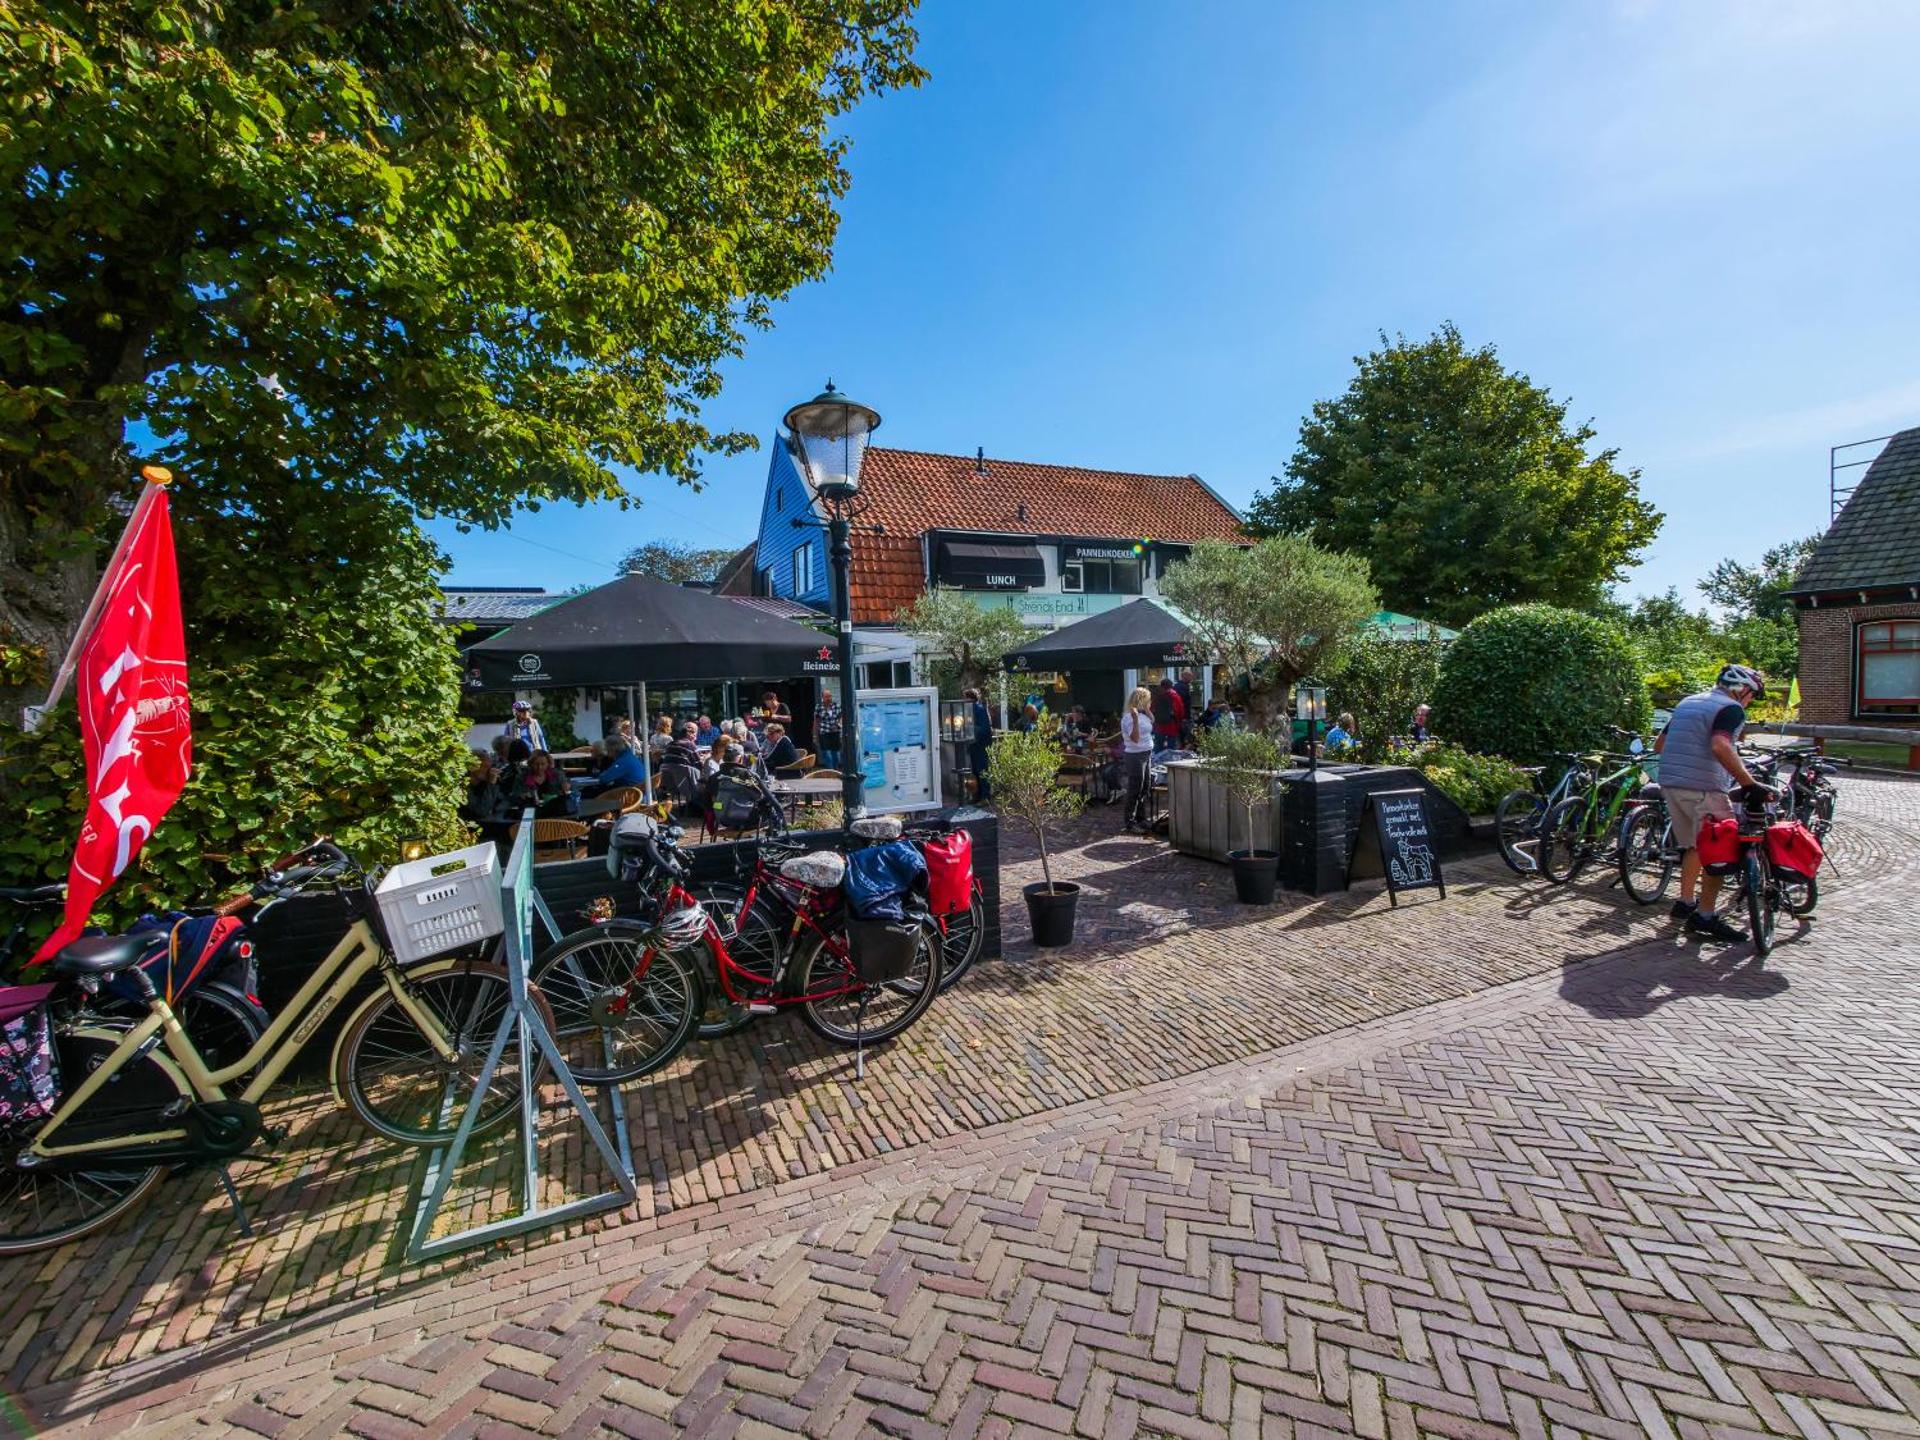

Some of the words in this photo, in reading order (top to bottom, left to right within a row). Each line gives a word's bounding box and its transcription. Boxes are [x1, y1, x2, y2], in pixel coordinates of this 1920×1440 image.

[1076, 548, 1136, 559] PANNENKOEKEN
[986, 575, 1016, 585] LUNCH
[1056, 600, 1073, 612] End
[803, 661, 840, 671] Heineke
